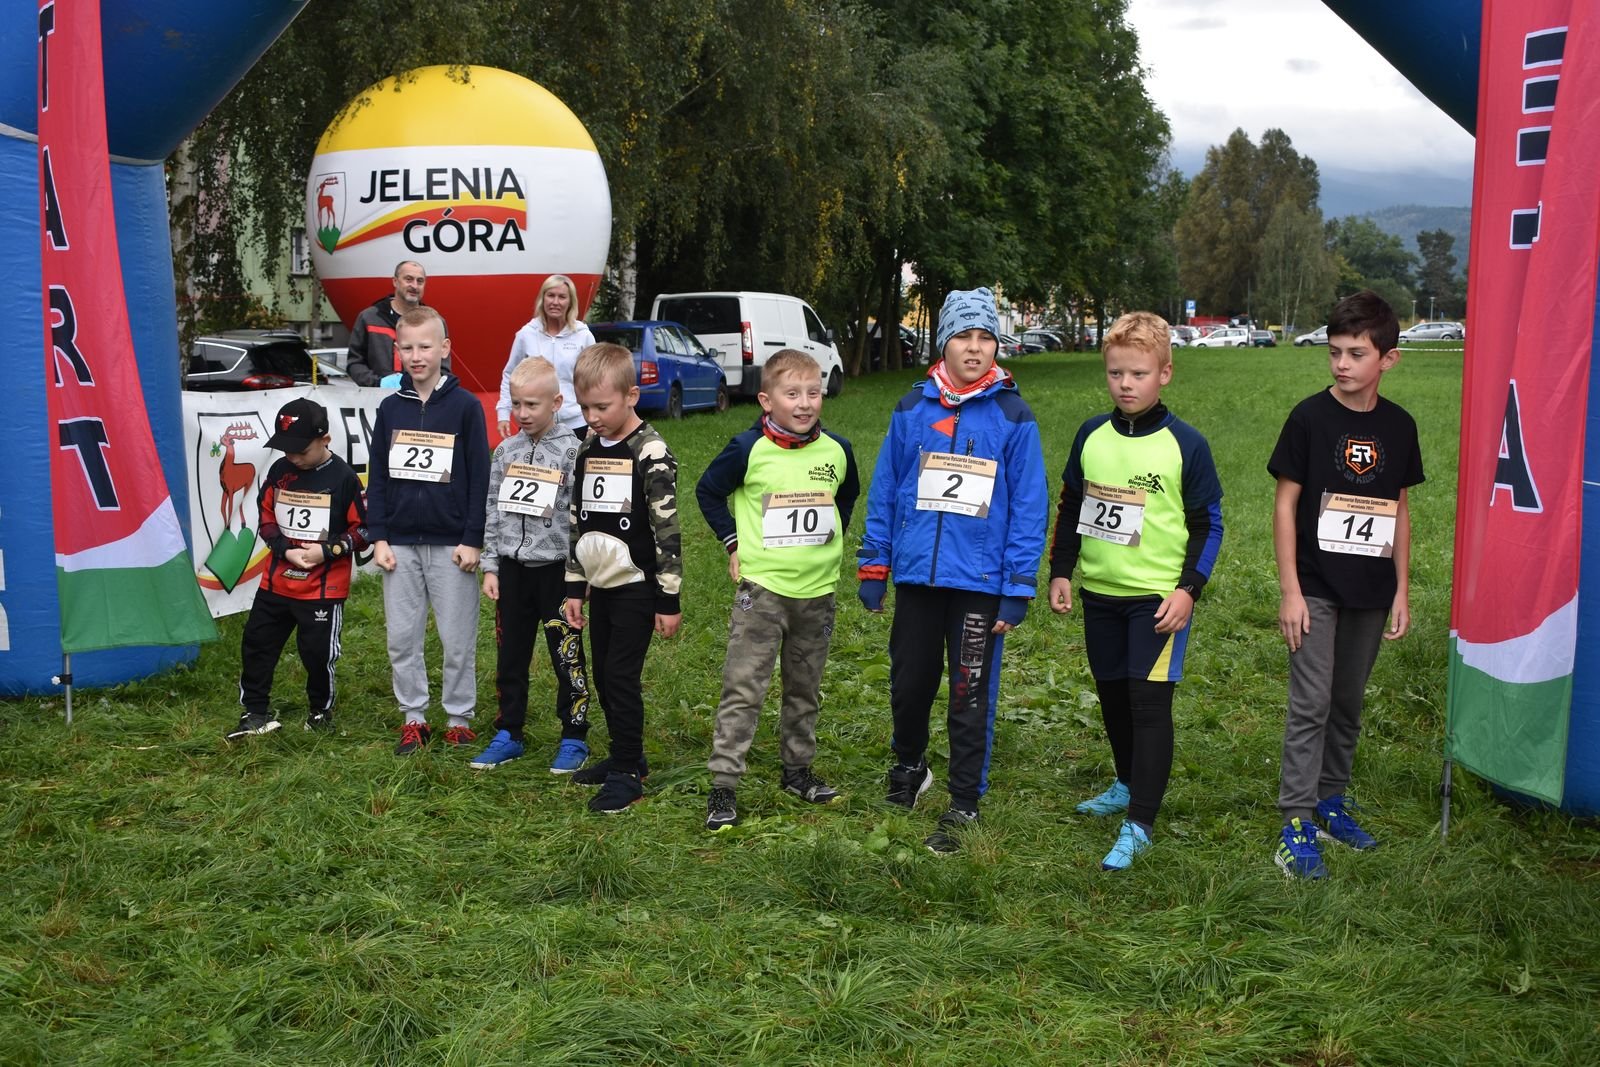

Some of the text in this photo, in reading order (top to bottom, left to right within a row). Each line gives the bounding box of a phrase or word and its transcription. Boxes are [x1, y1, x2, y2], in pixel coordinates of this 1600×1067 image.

[360, 167, 525, 204] JELENIA
[403, 207, 526, 253] GÓRA
[404, 446, 434, 469] 23
[510, 480, 539, 503] 22
[593, 476, 605, 499] 6
[942, 474, 963, 499] 2
[287, 507, 311, 529] 13
[787, 508, 818, 533] 10
[1094, 502, 1124, 529] 25
[1342, 515, 1374, 541] 14
